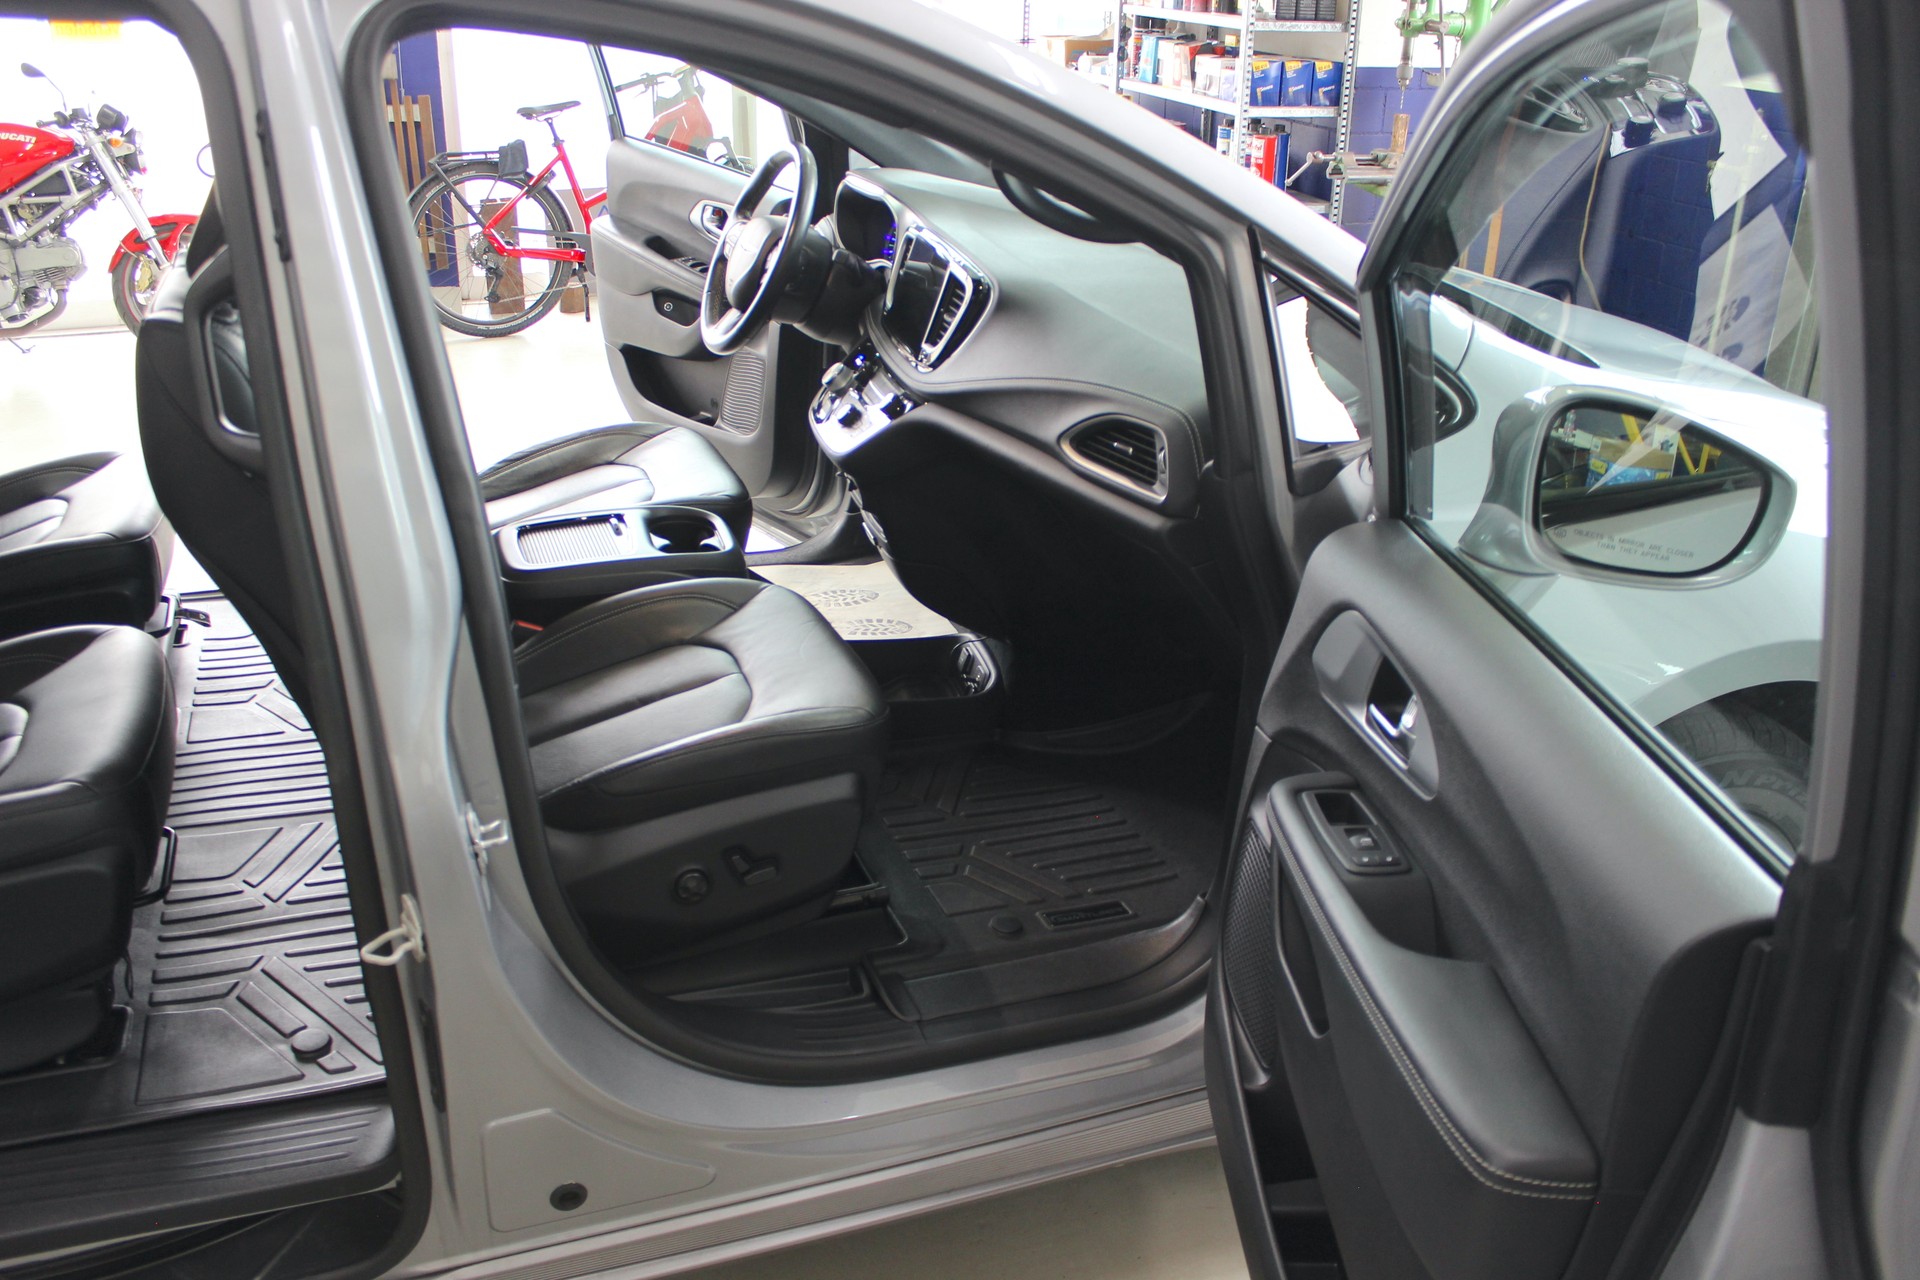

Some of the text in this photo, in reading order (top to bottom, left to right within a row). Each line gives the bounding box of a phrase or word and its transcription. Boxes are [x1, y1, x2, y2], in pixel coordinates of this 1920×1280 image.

[0, 133, 37, 144] UCATI
[1574, 529, 1604, 541] OBJECTS
[1618, 536, 1645, 548] MIRROR
[1649, 542, 1662, 552] ARE
[1666, 547, 1695, 559] CLOSER
[1597, 541, 1670, 561] THAN THEY APPEAR
